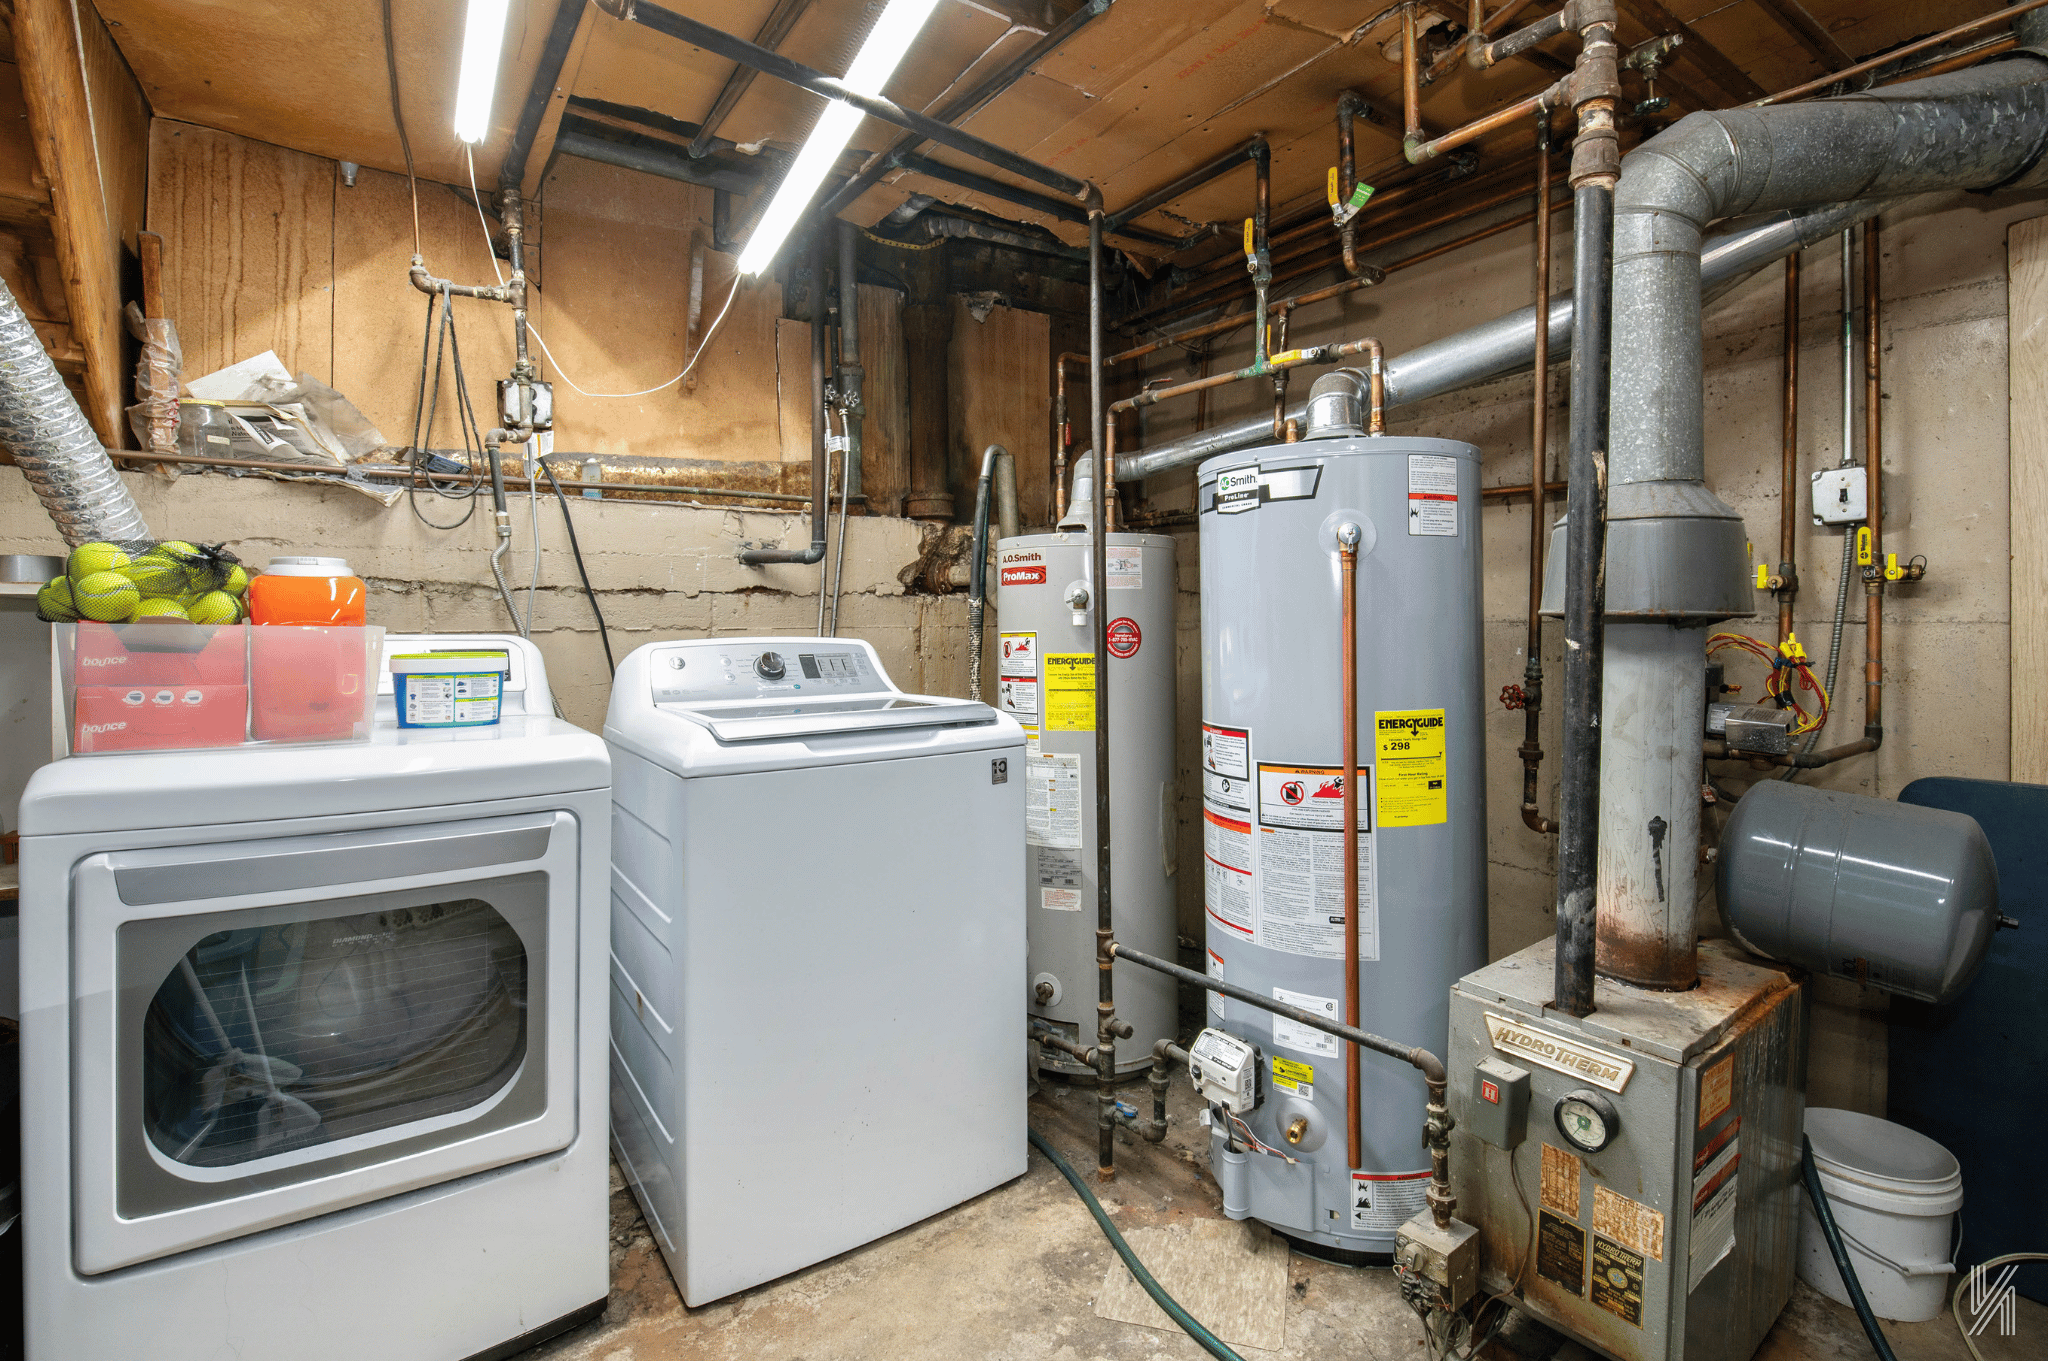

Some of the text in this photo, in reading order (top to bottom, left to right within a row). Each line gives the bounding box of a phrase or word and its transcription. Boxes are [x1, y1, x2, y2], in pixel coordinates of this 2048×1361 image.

[82, 656, 127, 667] bounce
[81, 721, 127, 733] bounce
[1378, 716, 1444, 732] ENERGYGUIDE
[1390, 742, 1411, 751] 298
